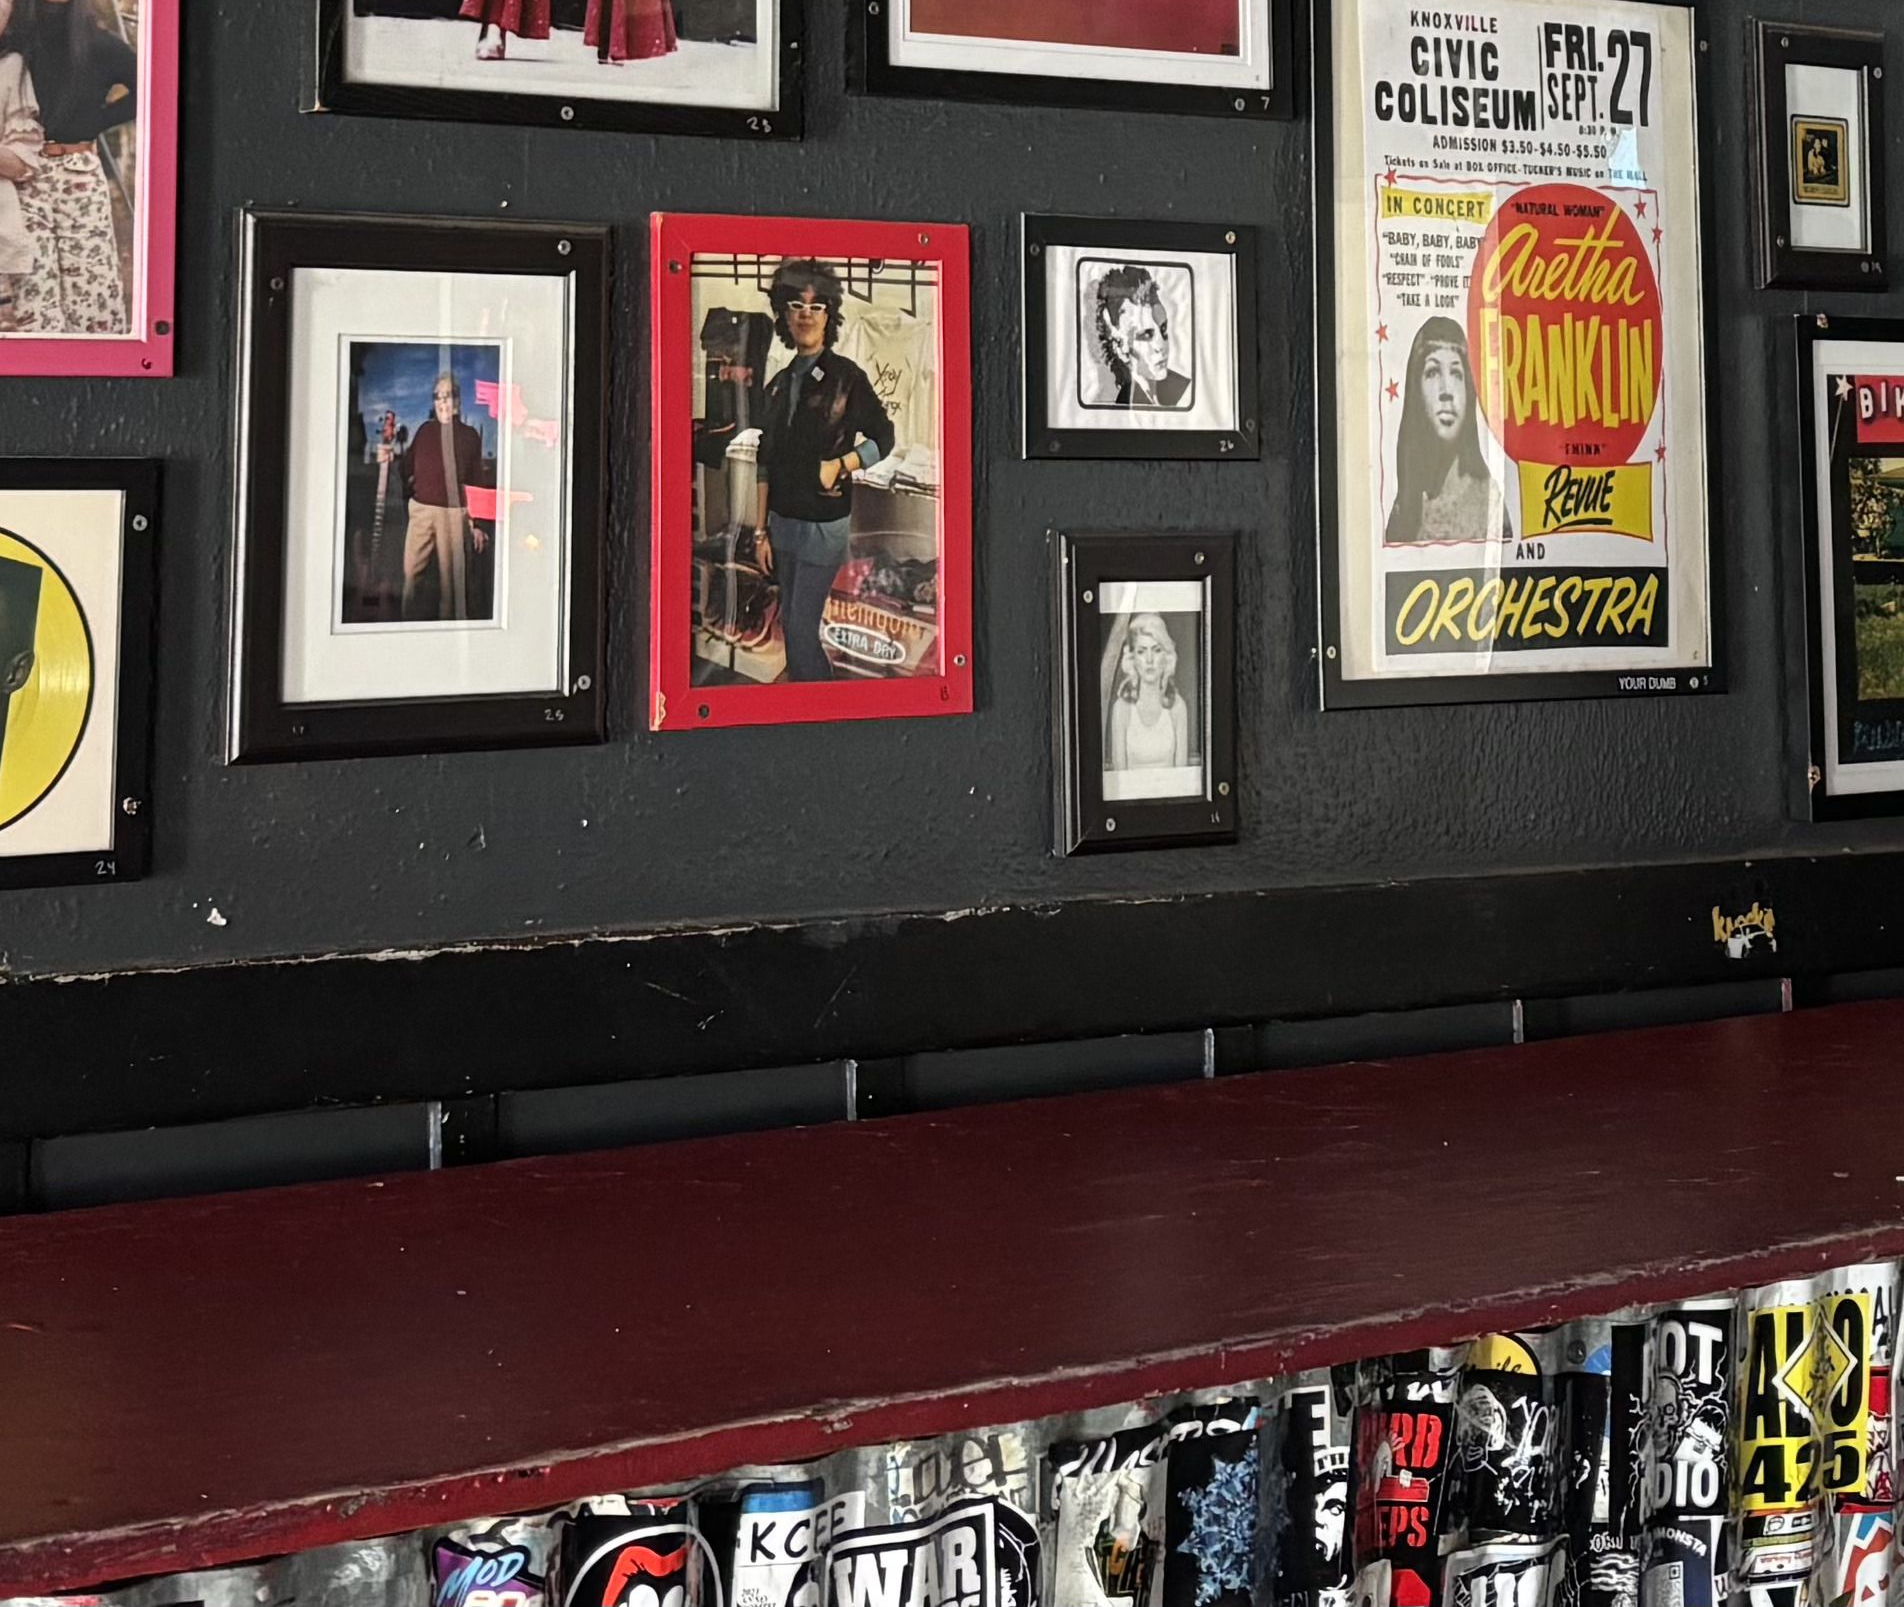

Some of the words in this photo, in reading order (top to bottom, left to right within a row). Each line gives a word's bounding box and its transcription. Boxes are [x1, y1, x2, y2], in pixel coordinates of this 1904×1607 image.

[1410, 10, 1498, 34] KNOXVILLE
[1410, 36, 1499, 81] CIVIC
[1544, 22, 1604, 72] FRI.
[1607, 29, 1652, 127] 27
[1261, 96, 1270, 110] 7
[1374, 81, 1536, 132] COLISEUM
[1547, 72, 1604, 122] SEPT.
[1433, 135, 1496, 152] ADMISSION
[1502, 137, 1607, 159] $3.50-$4.50-$5.50
[1387, 196, 1402, 214] IN
[1413, 197, 1484, 217] CONCERT
[1383, 232, 1419, 249] "BABY,
[1423, 234, 1452, 250] BABY,
[1484, 203, 1644, 306] Aretha
[1383, 272, 1425, 286] "RESPECT"
[1397, 293, 1421, 306] "TAKE
[1425, 294, 1430, 306] A
[1436, 294, 1459, 307] LOOK"
[1479, 308, 1654, 429] FRANKLIN
[1515, 543, 1545, 560] AND
[1396, 573, 1659, 645] ORCHESTRA
[833, 627, 867, 652] EXTRA
[873, 641, 896, 659] DRY
[1618, 677, 1644, 690] YOUR
[1648, 677, 1676, 689] DUMB
[95, 860, 116, 875] 24
[834, 1525, 980, 1607] WAR
